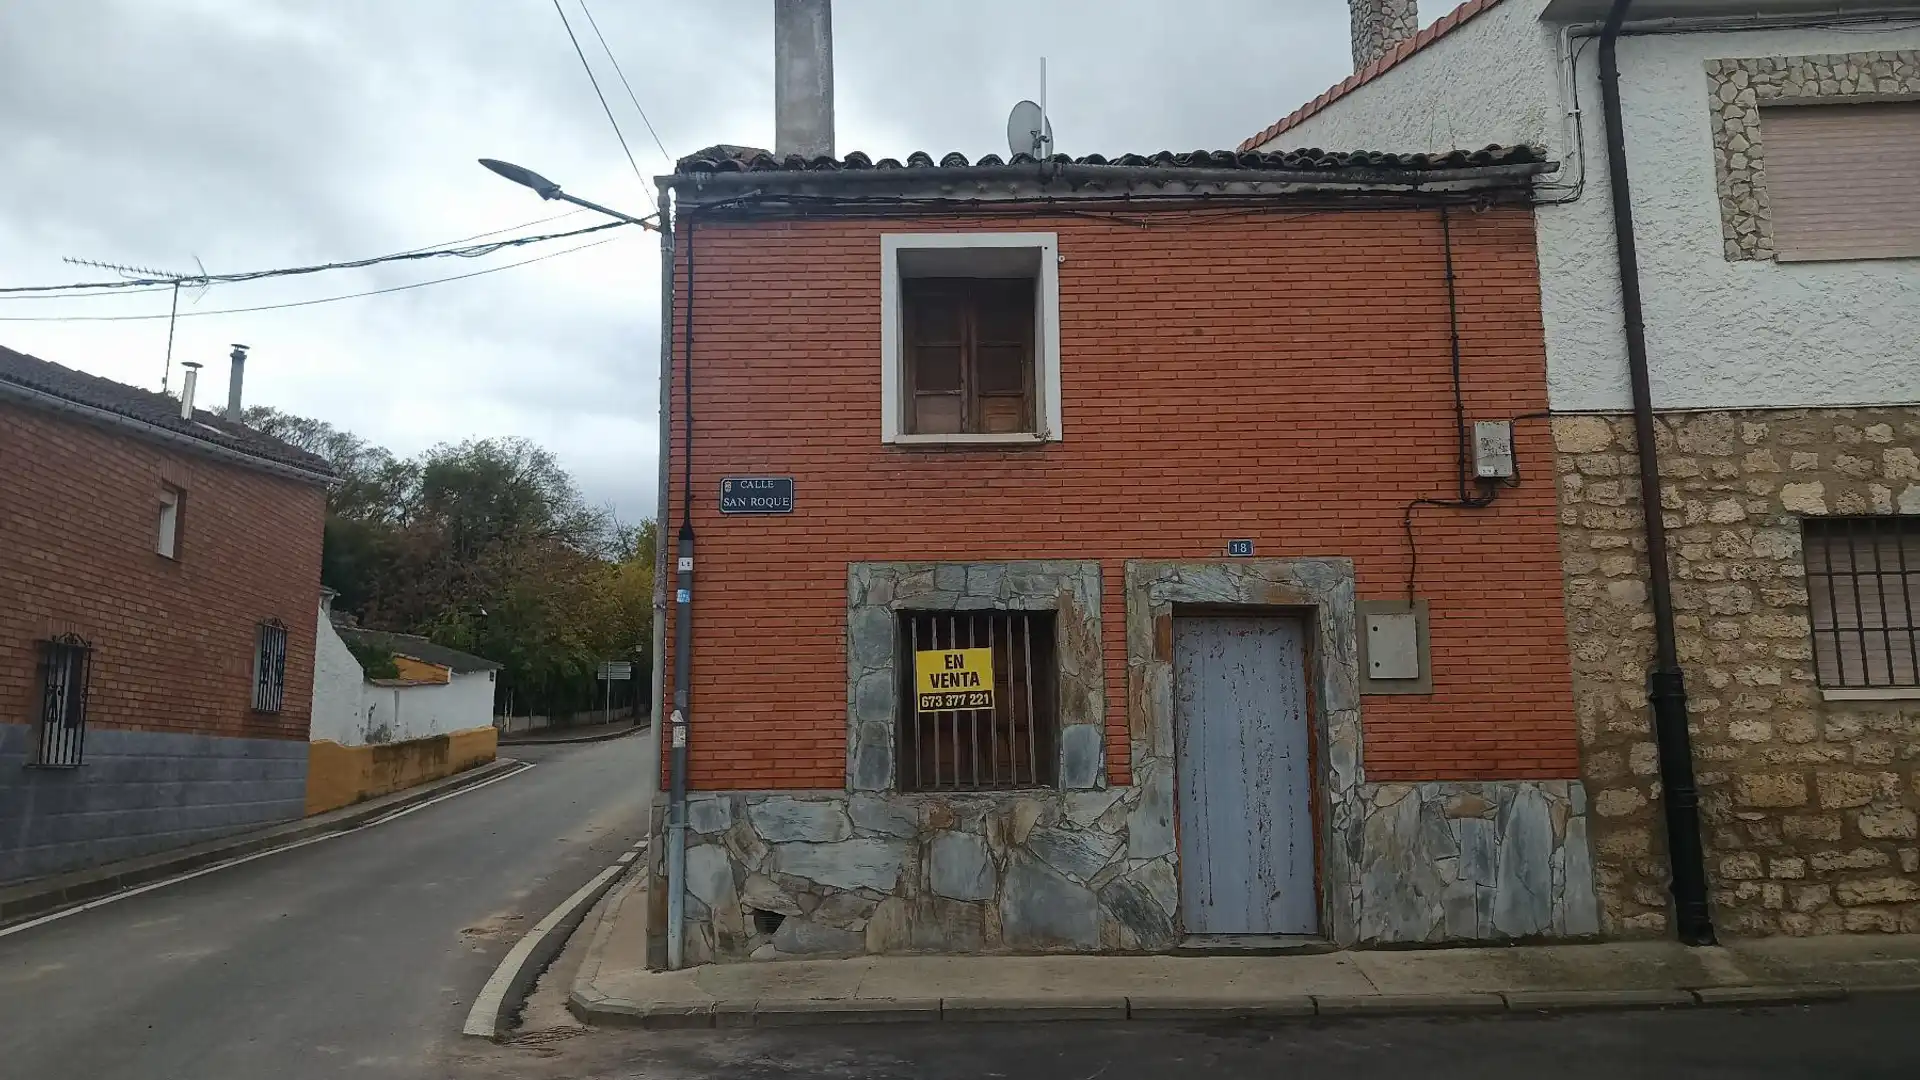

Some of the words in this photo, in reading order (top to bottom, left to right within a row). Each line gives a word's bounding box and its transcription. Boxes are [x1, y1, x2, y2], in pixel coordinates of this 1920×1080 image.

[740, 480, 775, 489] CALLE
[723, 497, 747, 507] SAN
[750, 497, 790, 508] ROQUE
[1233, 543, 1247, 553] 18
[944, 654, 964, 670] EN
[929, 671, 980, 689] VENTA
[921, 695, 943, 708] 673
[945, 694, 967, 707] 377
[969, 693, 989, 706] 221
